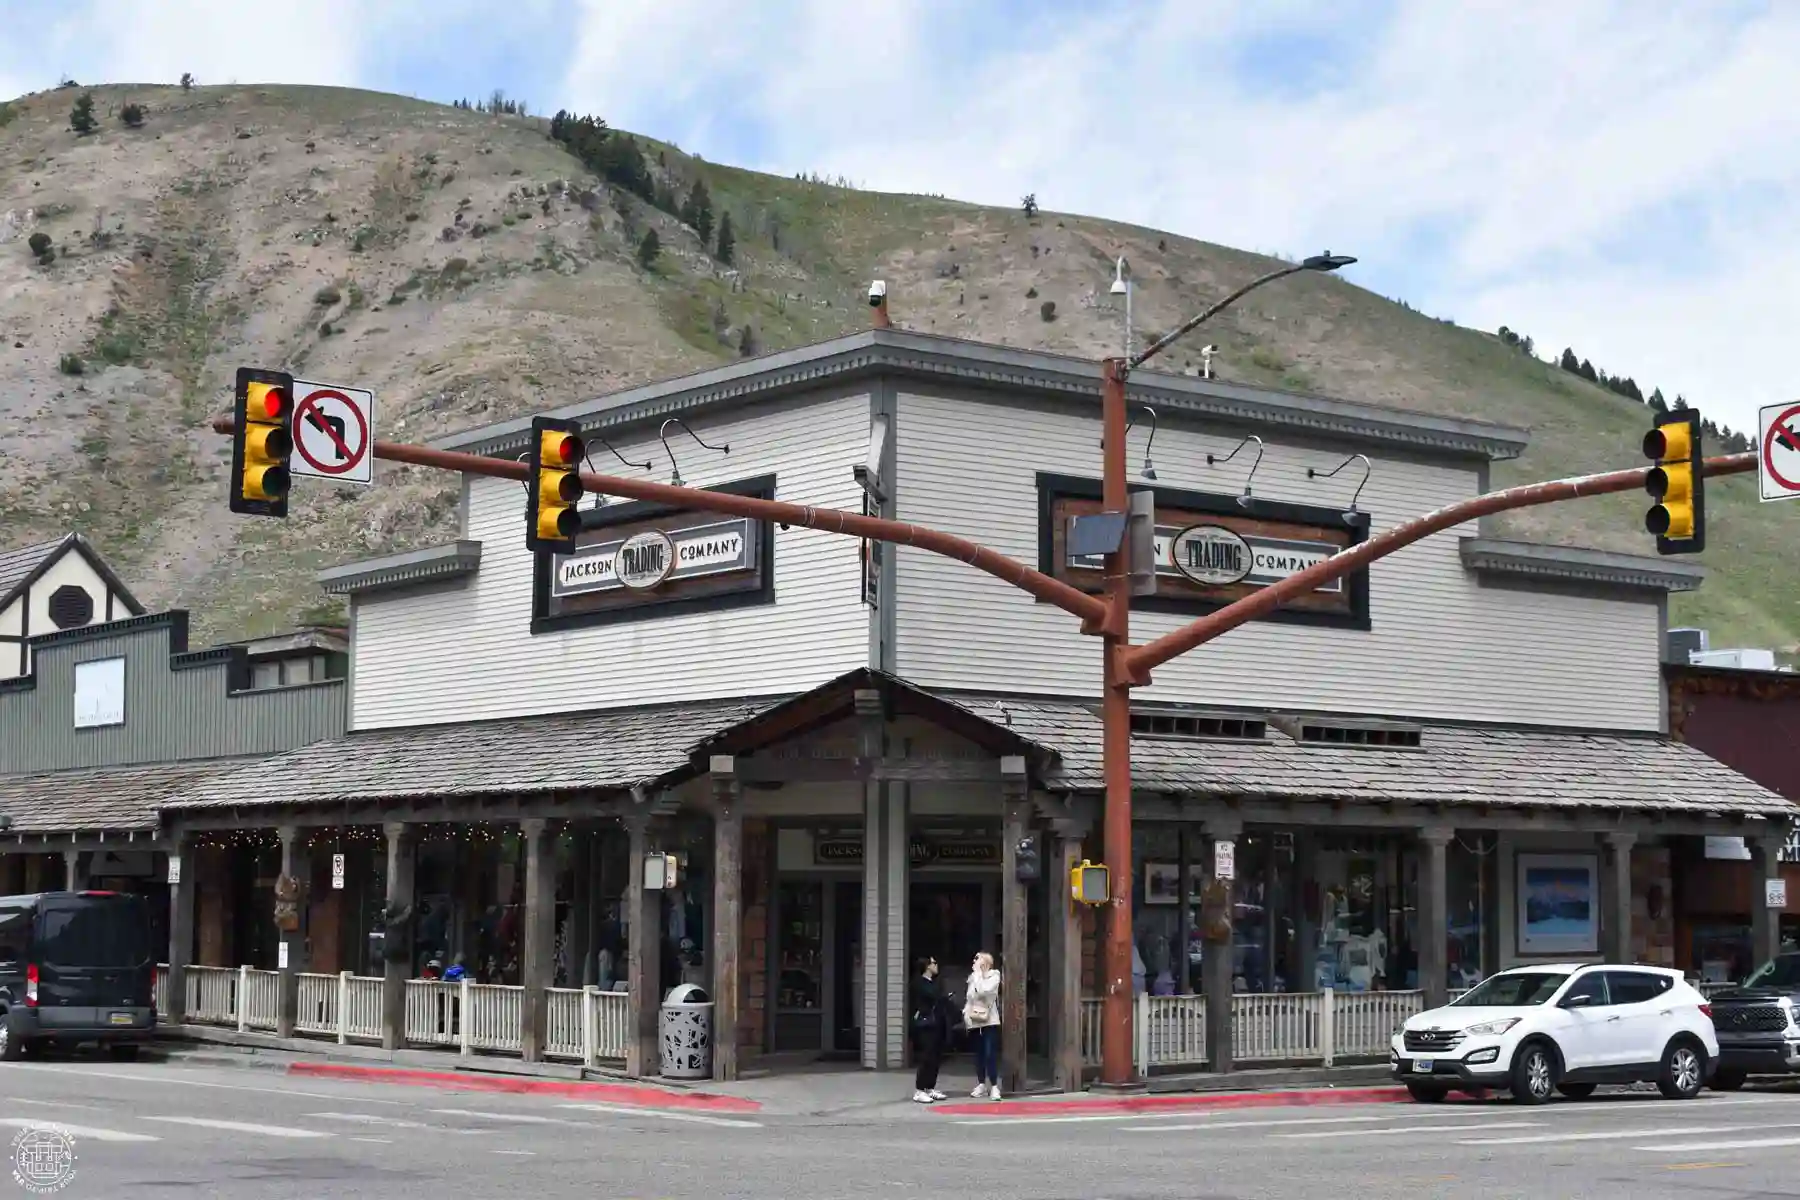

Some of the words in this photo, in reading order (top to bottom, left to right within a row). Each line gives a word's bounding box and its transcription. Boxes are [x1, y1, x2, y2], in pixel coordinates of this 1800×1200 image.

[565, 559, 612, 582] JACKSON
[622, 543, 664, 577] TRADING
[680, 539, 738, 560] COMPANY
[1185, 539, 1241, 571] TRADING
[1255, 554, 1323, 571] COMPAN
